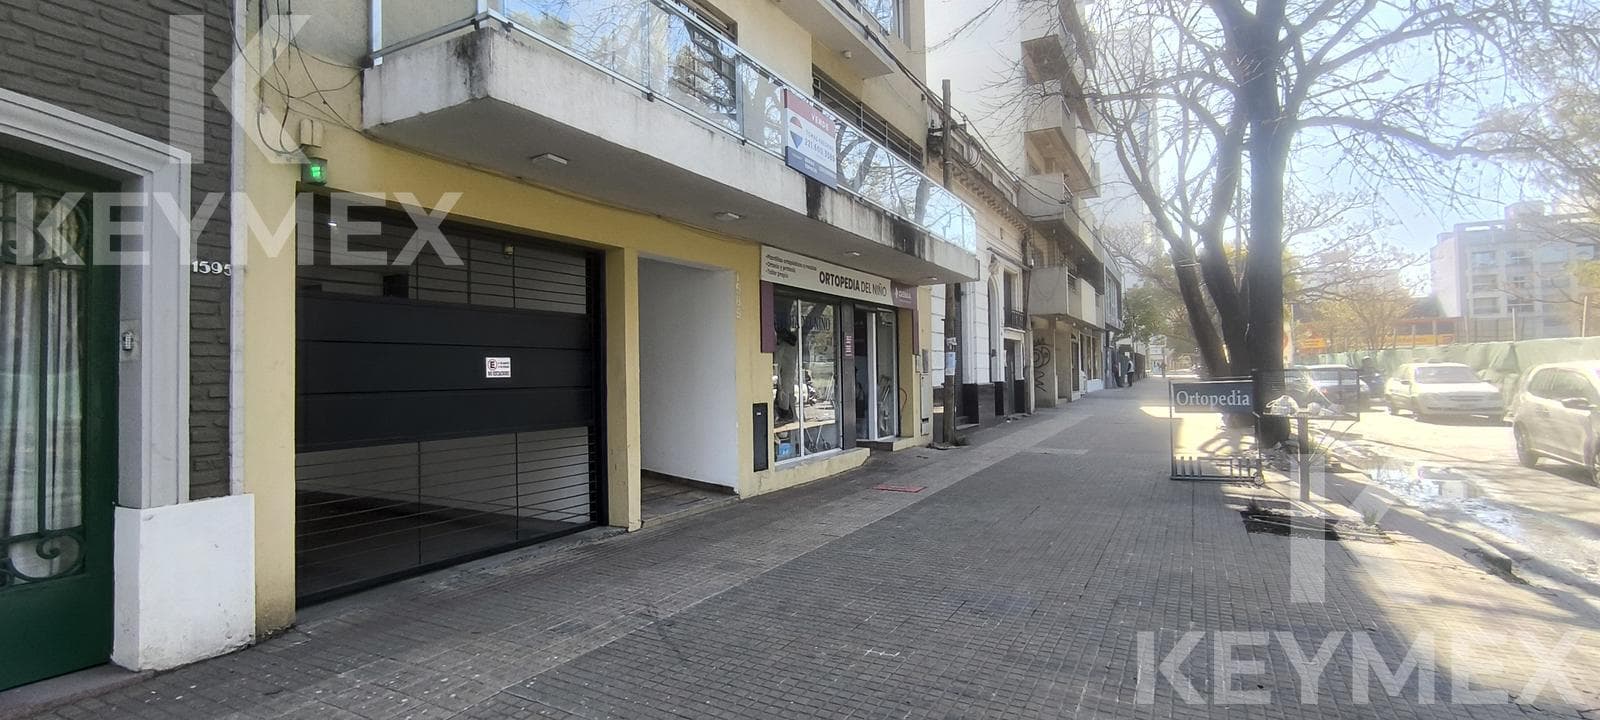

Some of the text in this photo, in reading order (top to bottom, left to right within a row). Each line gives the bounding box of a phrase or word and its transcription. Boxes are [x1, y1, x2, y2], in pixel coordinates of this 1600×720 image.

[191, 260, 232, 277] 1595
[819, 270, 860, 292] ORTOPEDIA
[860, 281, 872, 294] DEL
[872, 282, 887, 297] NIÑO
[490, 361, 495, 369] E
[1176, 390, 1250, 408] Ortopedia
